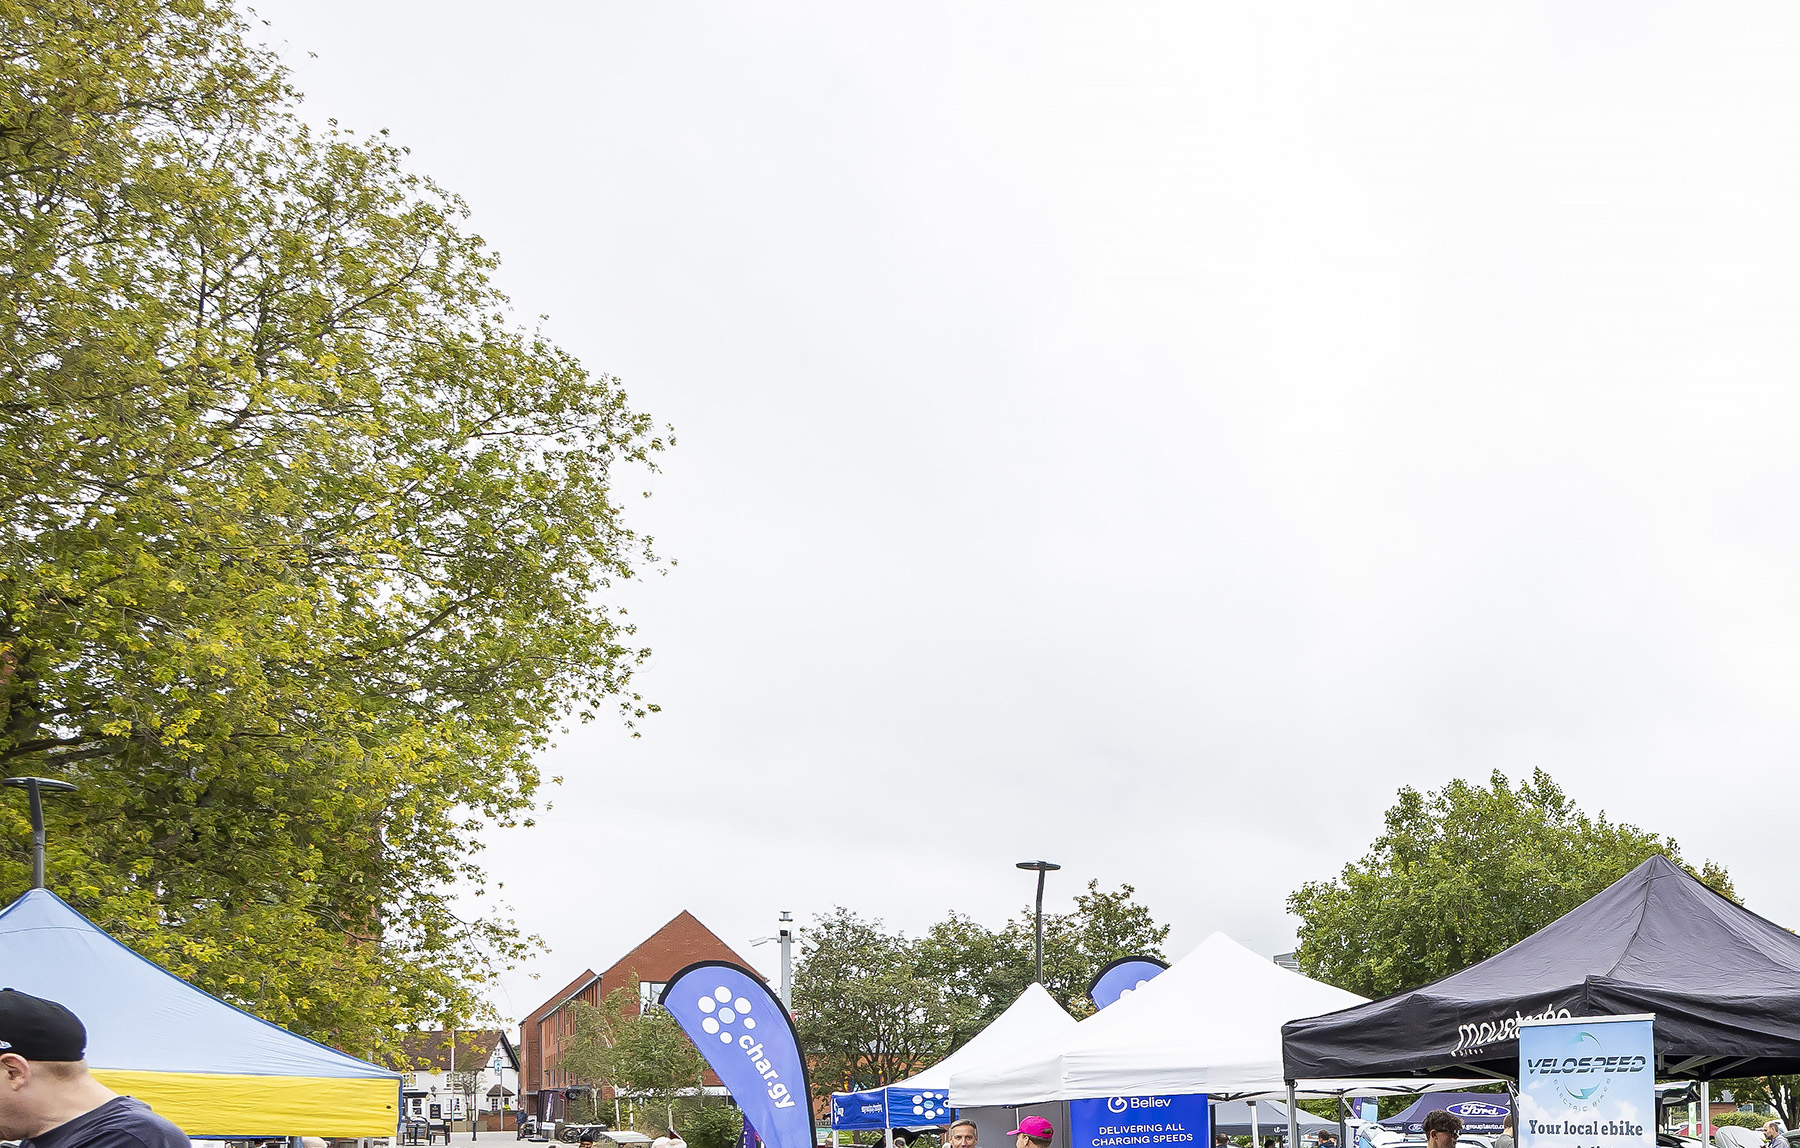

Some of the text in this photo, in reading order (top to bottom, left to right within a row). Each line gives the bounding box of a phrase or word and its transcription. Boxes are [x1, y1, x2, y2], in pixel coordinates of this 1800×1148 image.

[738, 1034, 796, 1109] char.gy
[1527, 1055, 1647, 1075] VELOSPEED
[1130, 1096, 1172, 1109] Believ
[1553, 1077, 1611, 1113] ELECTRIC BIKES
[1460, 1103, 1499, 1115] Ford
[1098, 1123, 1185, 1135] DELIVERING ALL
[1528, 1119, 1643, 1137] Your local ebike
[1091, 1133, 1193, 1147] CHARGING SPEEDS
